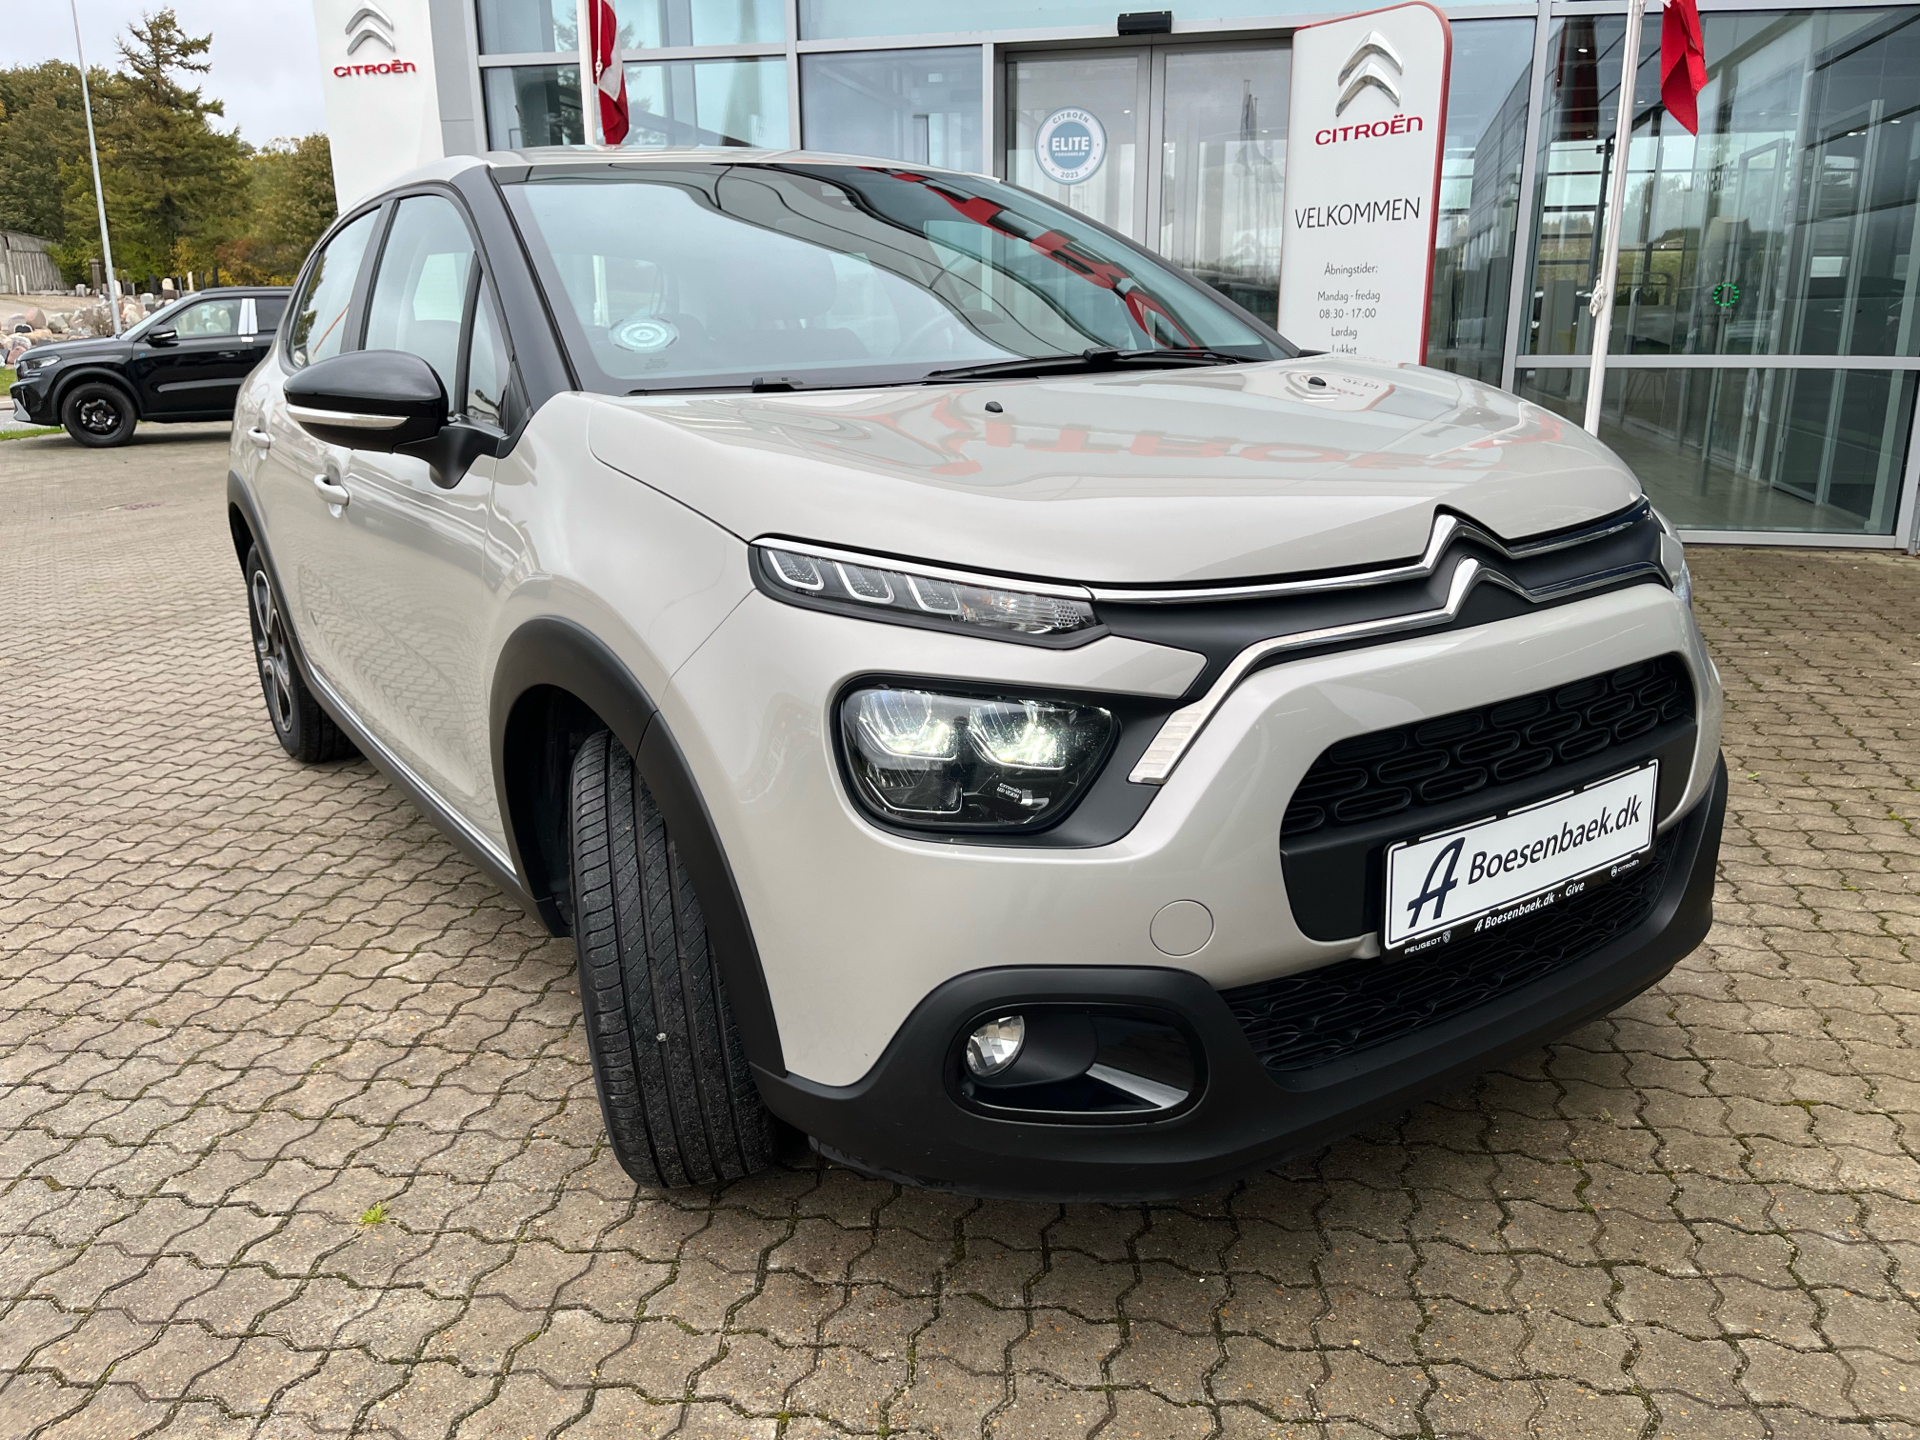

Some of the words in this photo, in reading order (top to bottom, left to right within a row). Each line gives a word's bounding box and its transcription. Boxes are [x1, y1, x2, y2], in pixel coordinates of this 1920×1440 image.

[333, 59, 417, 78] CITROËN
[1315, 113, 1423, 146] CITROËN
[1052, 136, 1090, 151] ELITE
[1060, 171, 1079, 179] 2023
[1294, 196, 1421, 229] VELKOMMEN
[1324, 262, 1379, 278] Åbningstider:
[1317, 290, 1349, 304] Mandag
[1355, 288, 1381, 303] fredag
[1319, 308, 1344, 319] 08:30
[1352, 307, 1377, 319] 17:00
[1331, 325, 1358, 340] Lørdag
[1467, 794, 1643, 885] Boesenbaek.dk
[1484, 892, 1555, 930] Boesenbaek.dk
[1565, 881, 1585, 897] Give
[1404, 936, 1442, 955] PEUGEOT
